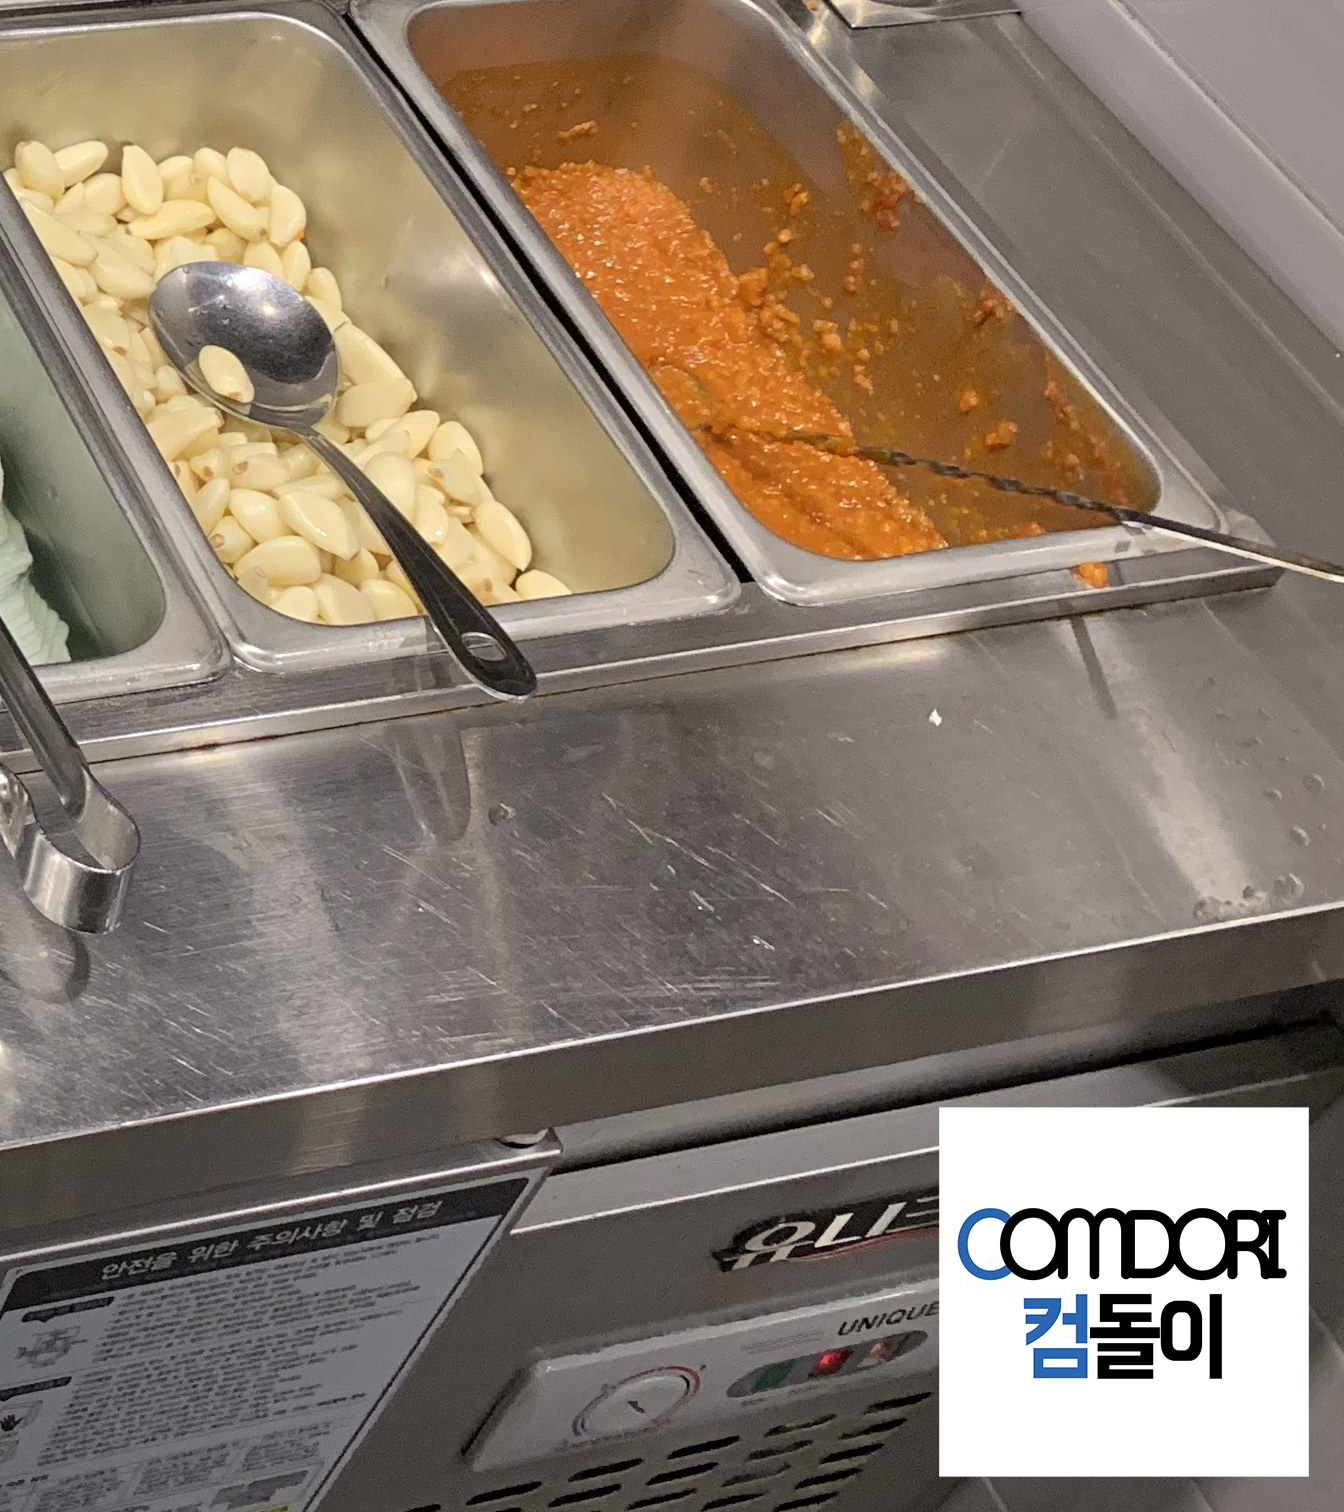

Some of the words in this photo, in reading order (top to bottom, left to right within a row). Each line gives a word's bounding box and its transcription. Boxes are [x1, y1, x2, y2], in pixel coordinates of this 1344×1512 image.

[101, 1249, 177, 1281] 안전을
[188, 1238, 241, 1265] 위한
[246, 1218, 349, 1252] 주의사항
